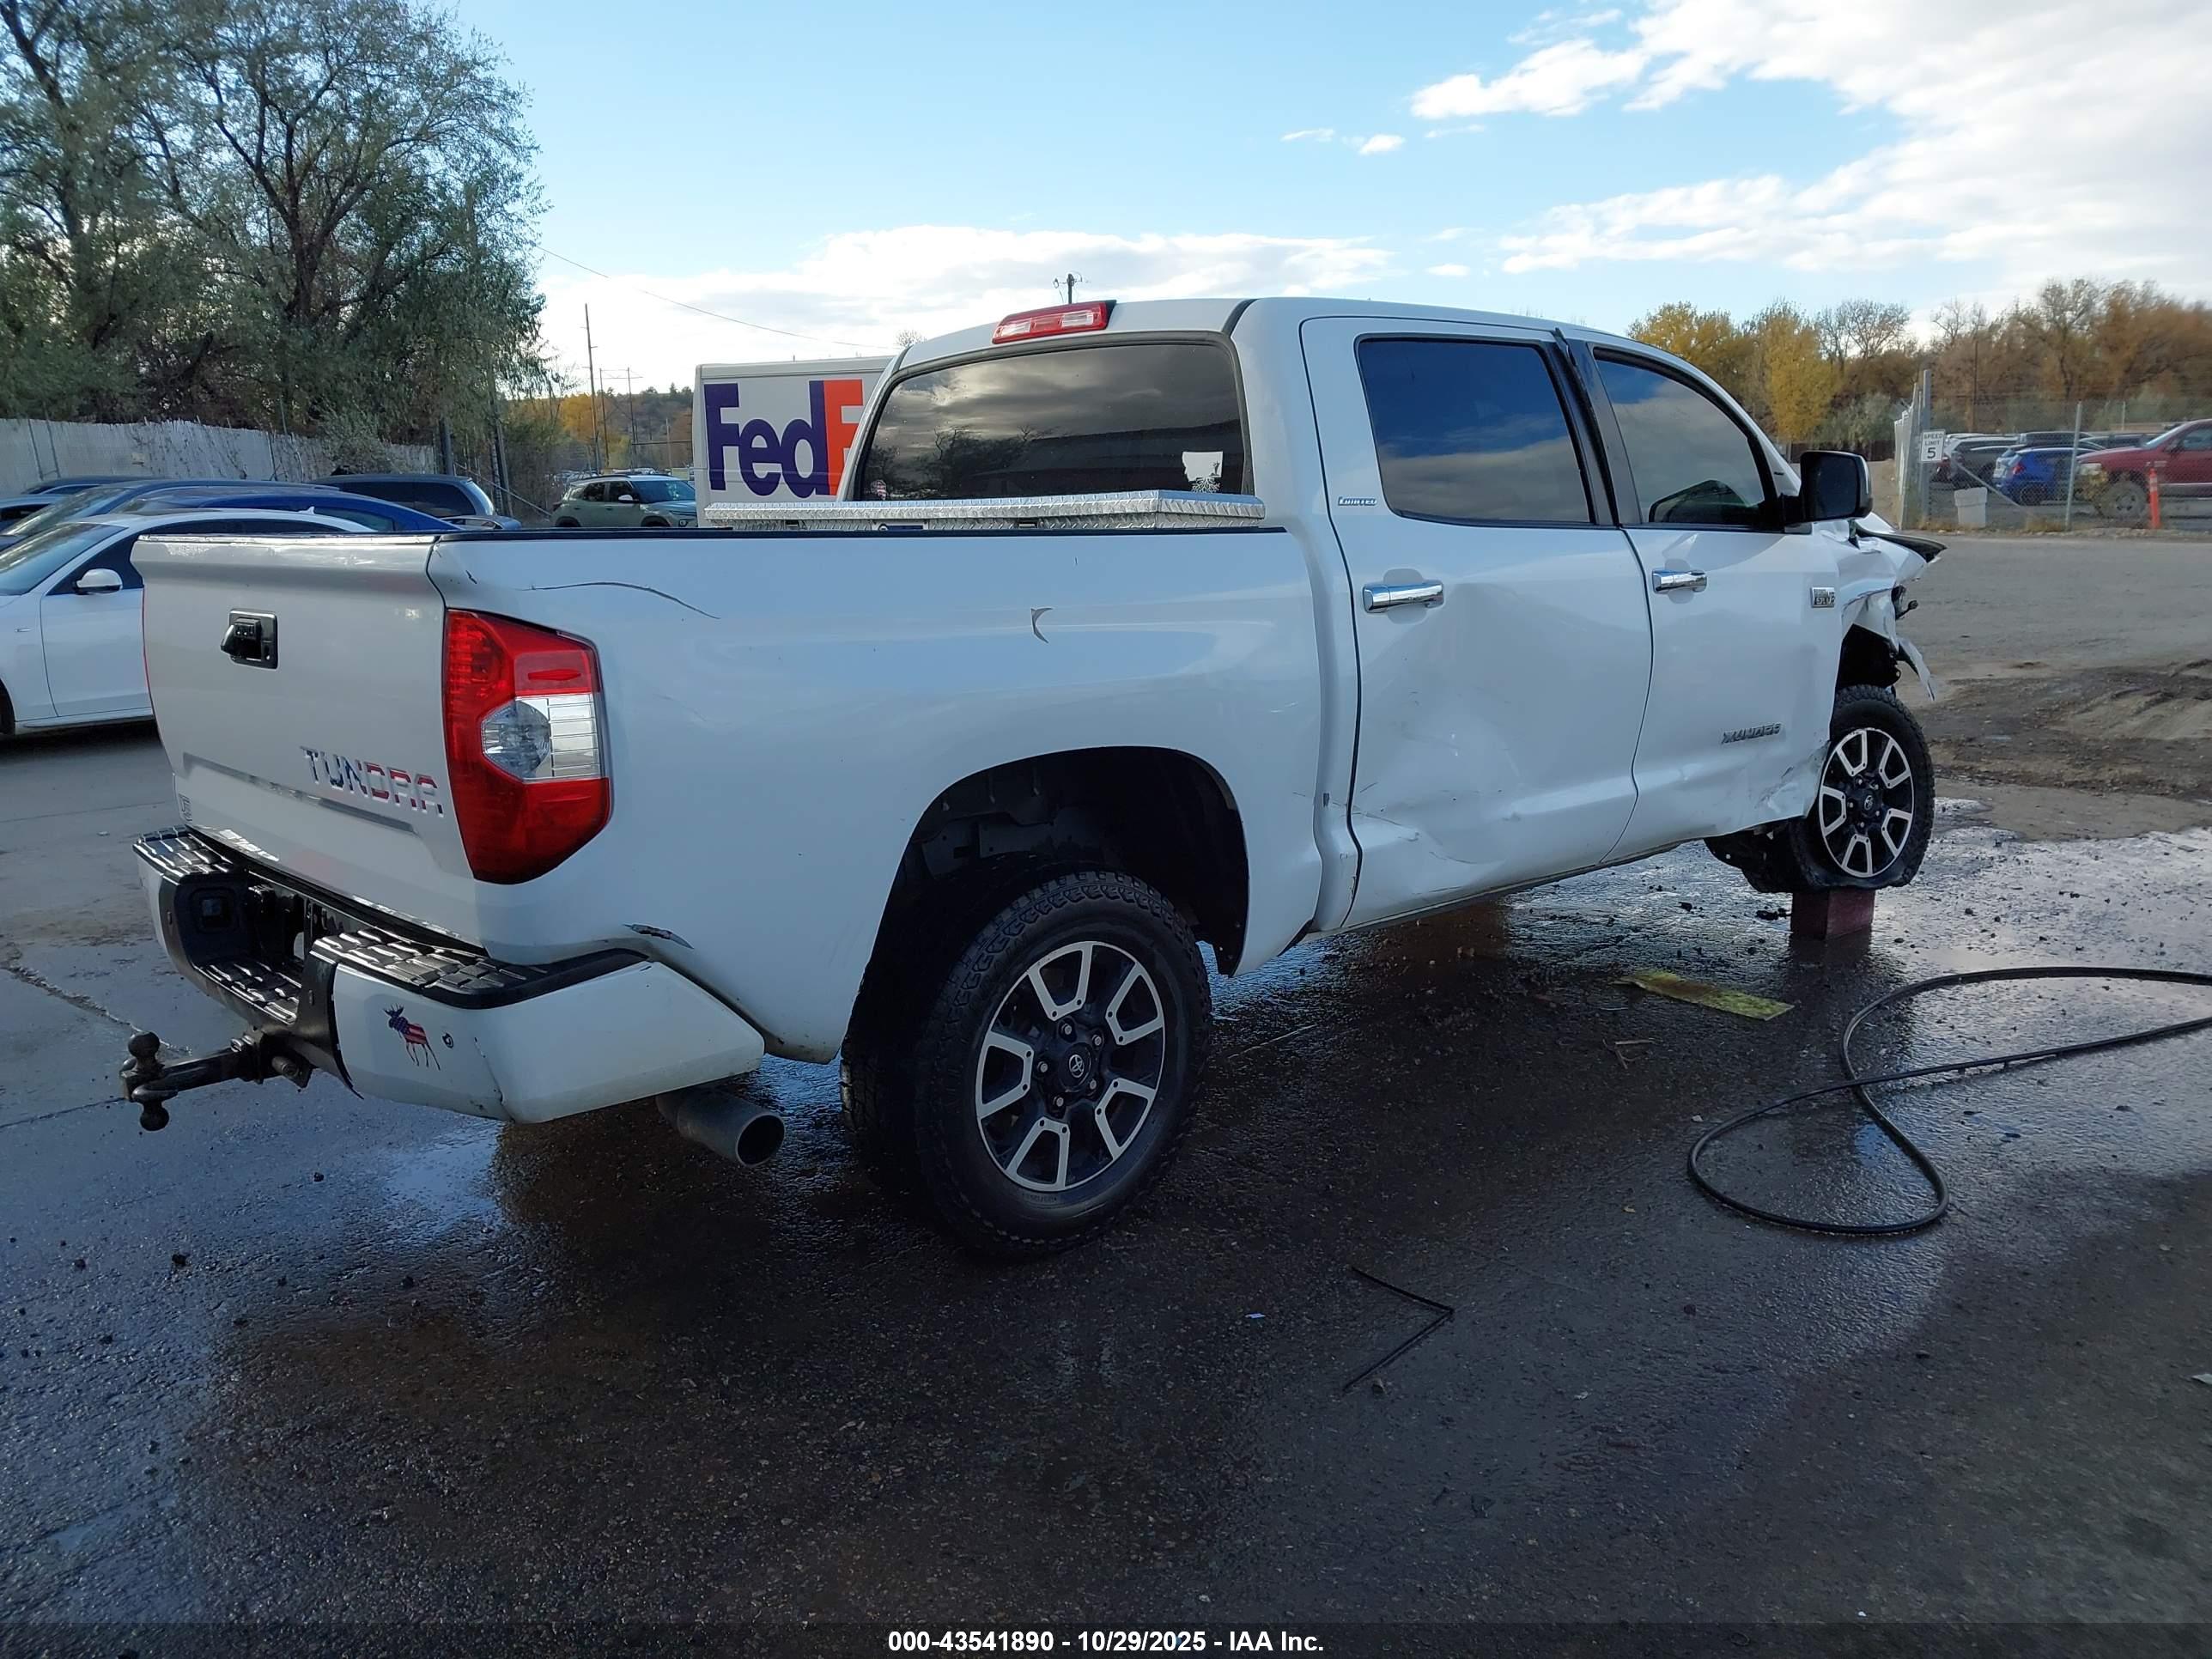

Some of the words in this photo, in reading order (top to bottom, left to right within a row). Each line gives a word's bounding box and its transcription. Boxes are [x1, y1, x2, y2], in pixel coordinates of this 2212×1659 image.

[703, 378, 864, 499] FedE
[1927, 447, 1936, 459] 5
[300, 745, 444, 817] TUNDRA
